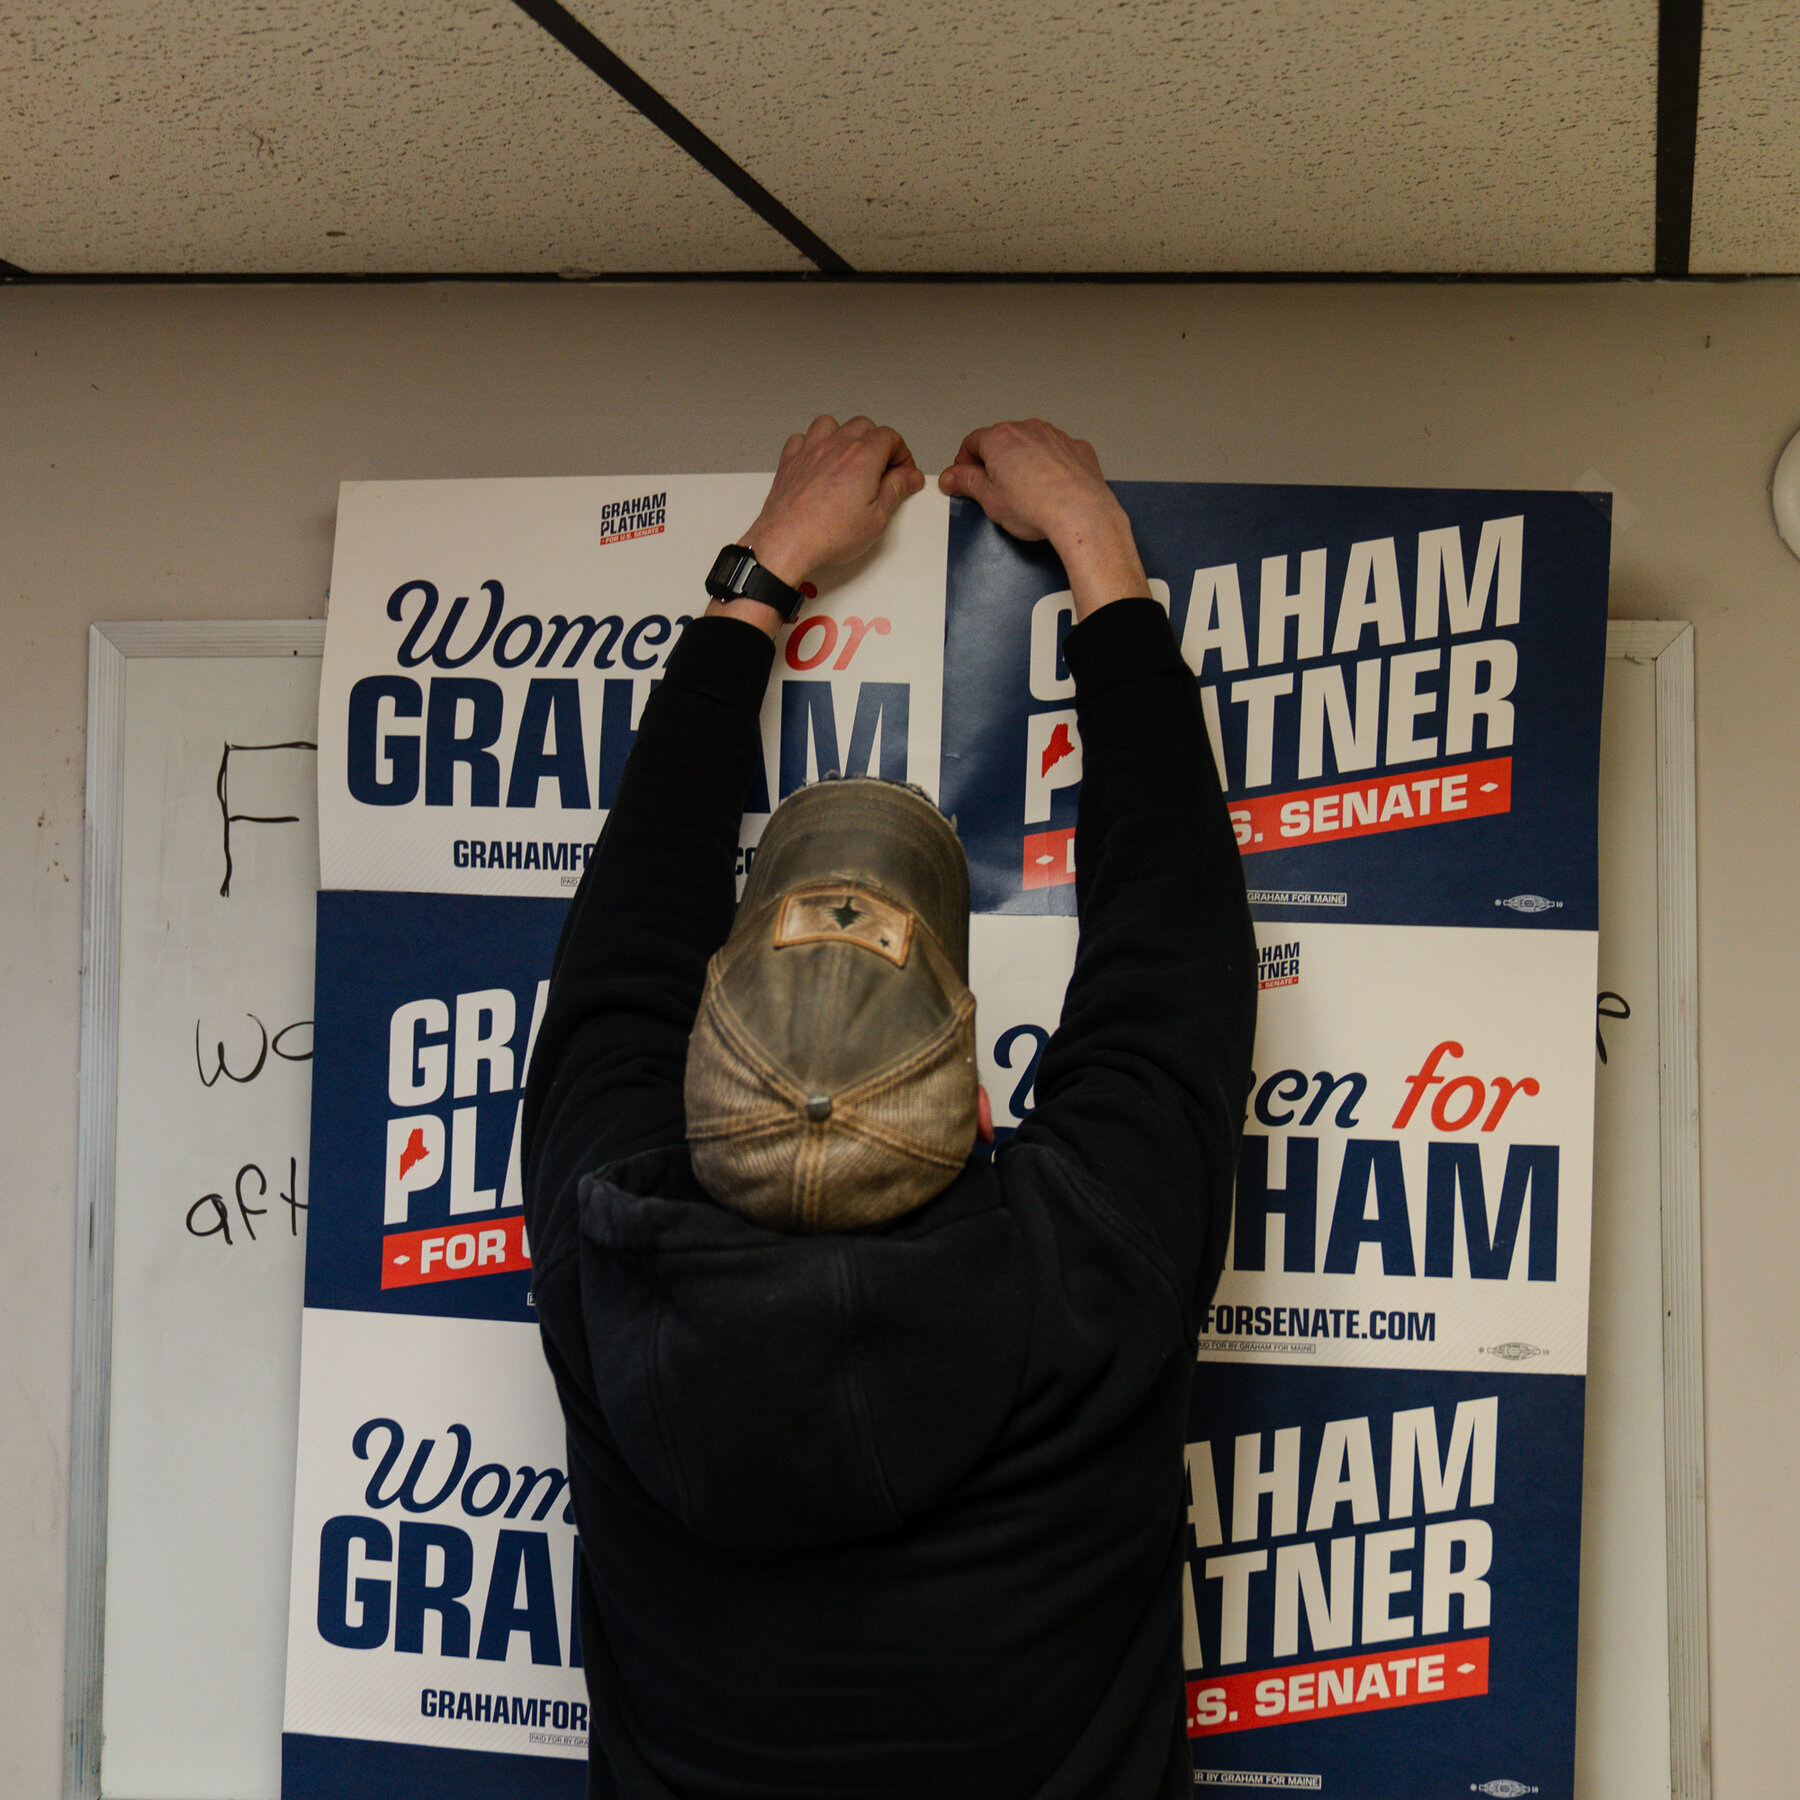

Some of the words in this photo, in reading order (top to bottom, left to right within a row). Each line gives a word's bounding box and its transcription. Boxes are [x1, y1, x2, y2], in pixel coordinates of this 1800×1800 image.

[600, 509, 666, 537] PLATNER
[602, 492, 667, 520] GRAHAM
[1279, 773, 1469, 840] SENATE
[1247, 892, 1289, 903] GRAHAM
[1291, 893, 1311, 904] FOR
[1313, 894, 1345, 905] MAINE
[1257, 942, 1300, 964] HAM
[1392, 1040, 1540, 1133] for
[420, 1228, 507, 1275] FOR
[317, 1514, 585, 1670] GRA
[1254, 1654, 1446, 1718] SENATE
[1206, 1772, 1219, 1782] BY
[1220, 1773, 1264, 1784] GRAHAM
[1265, 1775, 1286, 1786] FOR
[1287, 1776, 1319, 1788] MAINE
